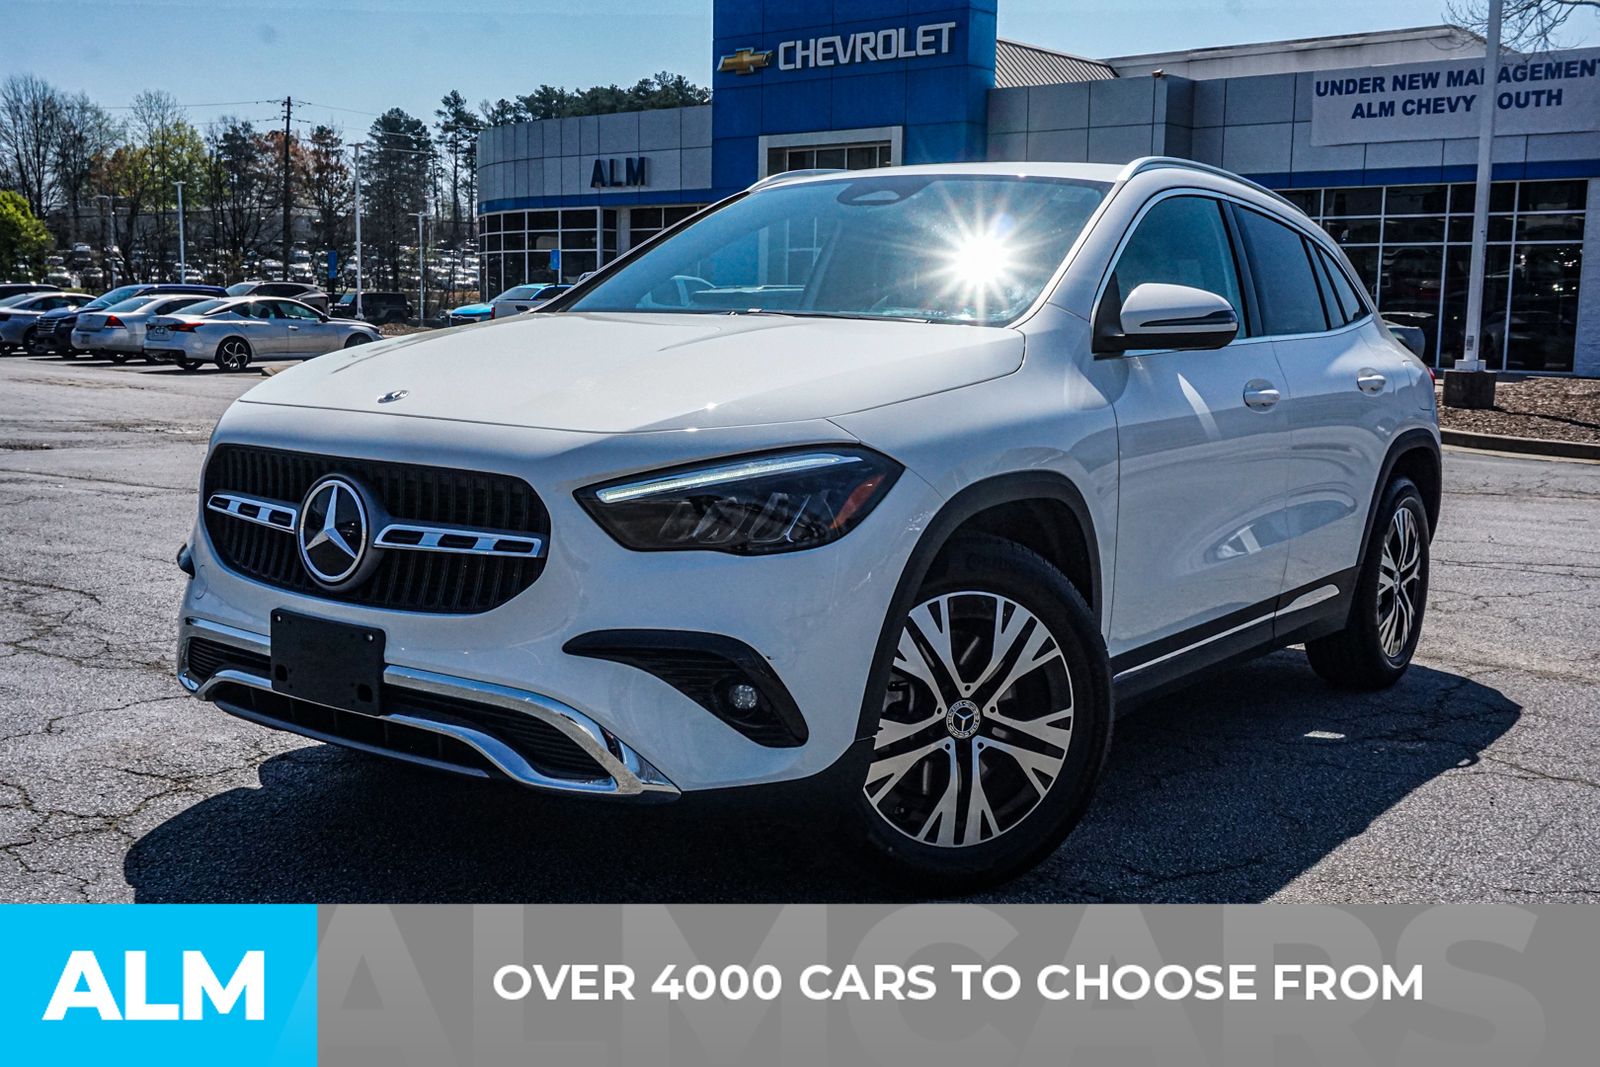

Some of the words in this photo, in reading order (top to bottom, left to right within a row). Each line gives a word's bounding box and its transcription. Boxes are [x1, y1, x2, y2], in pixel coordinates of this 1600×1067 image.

[777, 22, 956, 71] CHEVROLET
[1315, 76, 1385, 97] UNDER
[1391, 72, 1440, 92] NEW
[1446, 58, 1600, 88] MAAGEMEN
[1351, 100, 1395, 119] ALM
[1402, 94, 1477, 116] CHEVY
[1496, 88, 1563, 110] OUTH
[590, 156, 646, 188] ALM
